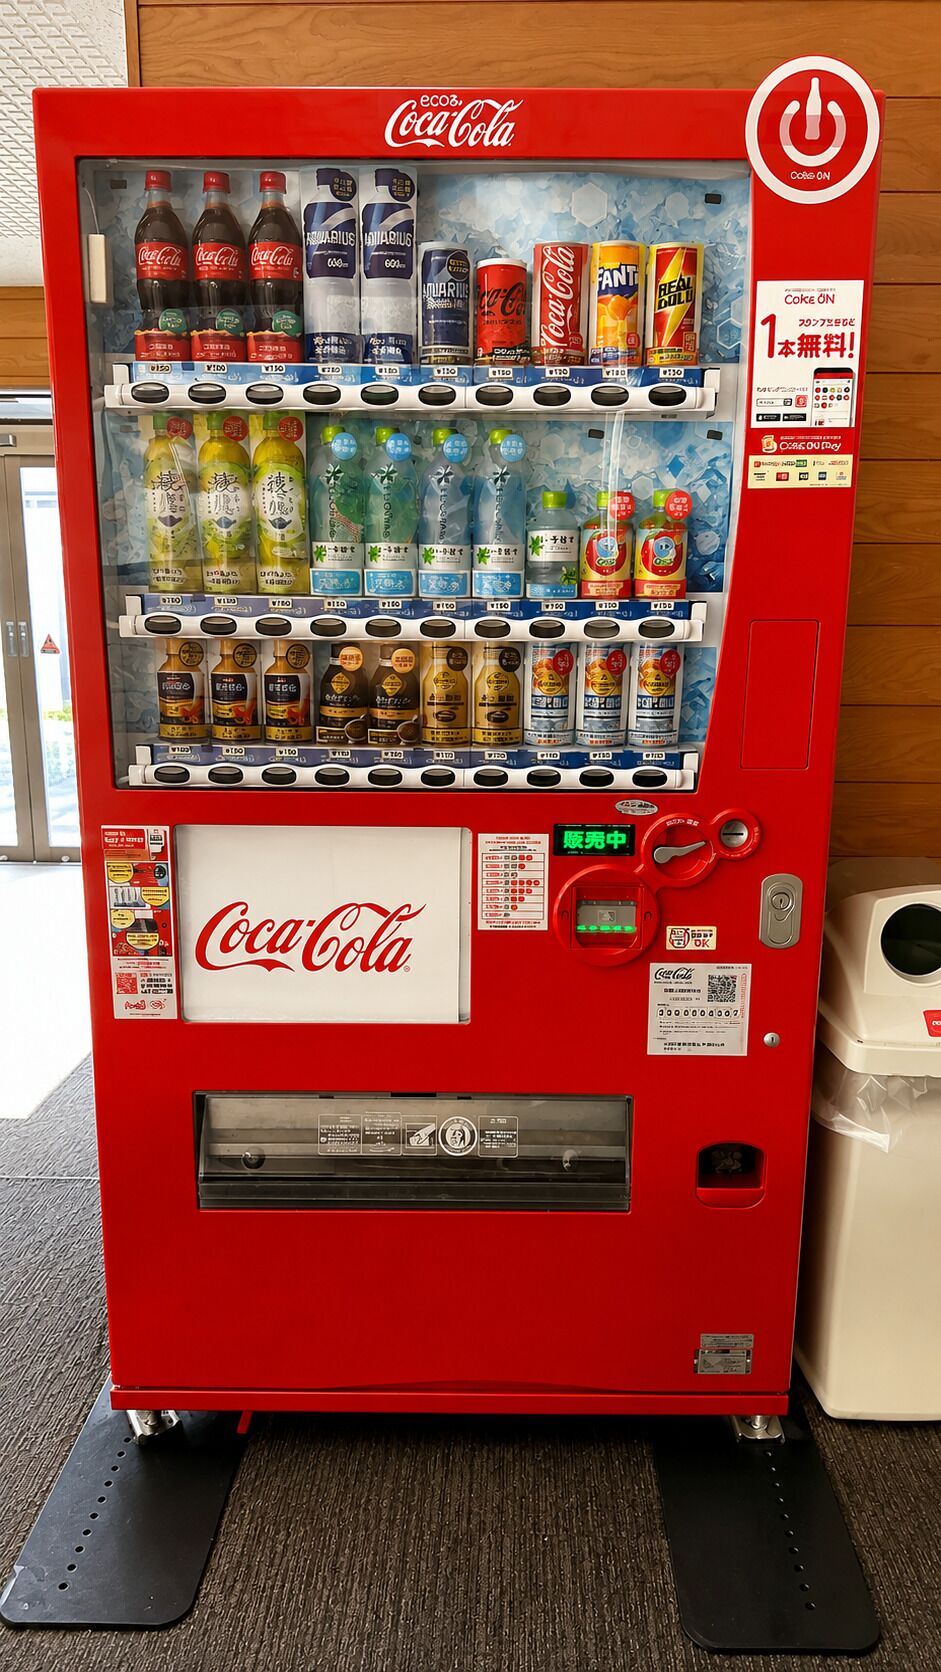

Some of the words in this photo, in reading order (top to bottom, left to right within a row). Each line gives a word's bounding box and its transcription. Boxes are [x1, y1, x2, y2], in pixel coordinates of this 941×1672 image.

[384, 99, 524, 148] Coca-Cola
[817, 293, 836, 304] ON
[563, 830, 627, 849] 販売中
[195, 901, 427, 973] Coca-Cola
